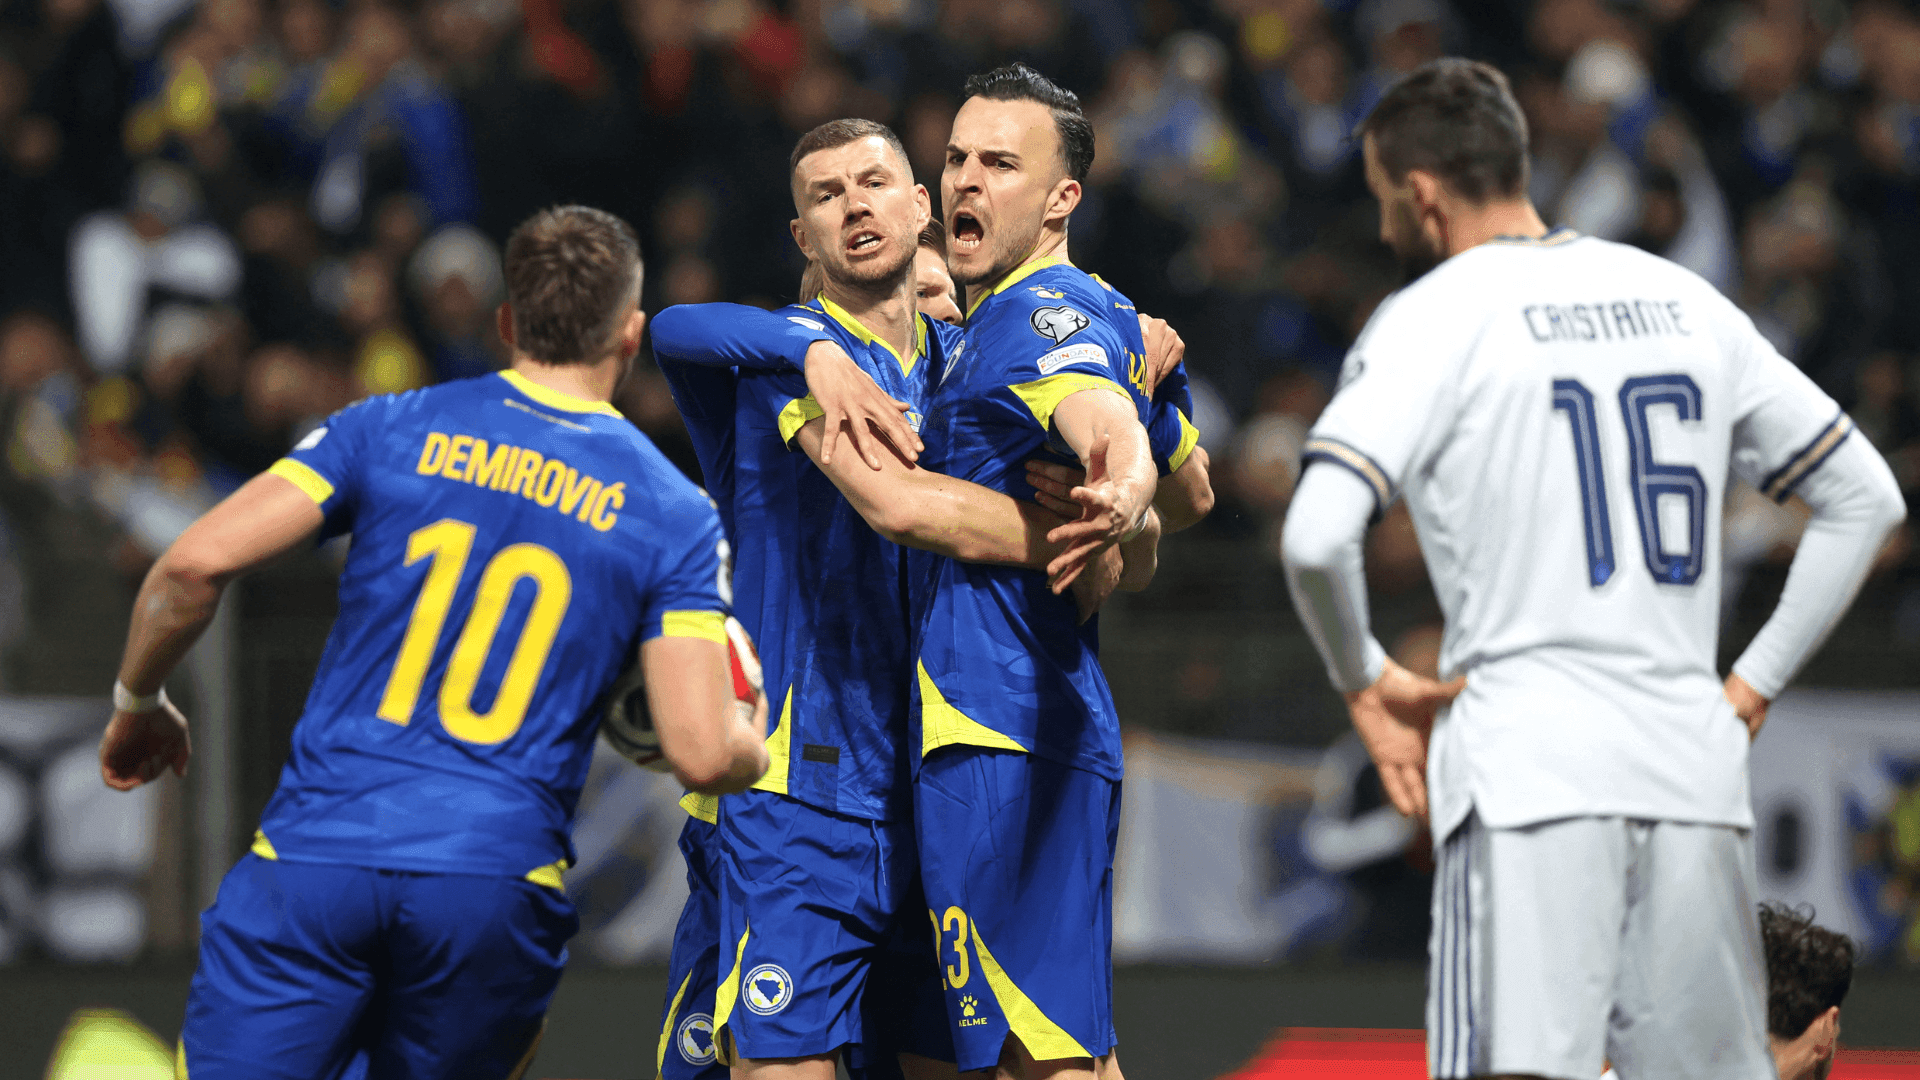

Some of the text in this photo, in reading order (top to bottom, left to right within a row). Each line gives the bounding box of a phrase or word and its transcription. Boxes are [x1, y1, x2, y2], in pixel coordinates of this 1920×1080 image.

[1521, 299, 1692, 343] CRISTANTE
[415, 431, 627, 532] DEMIROVIĆ
[1551, 373, 1709, 588] 16
[375, 518, 573, 745] 10
